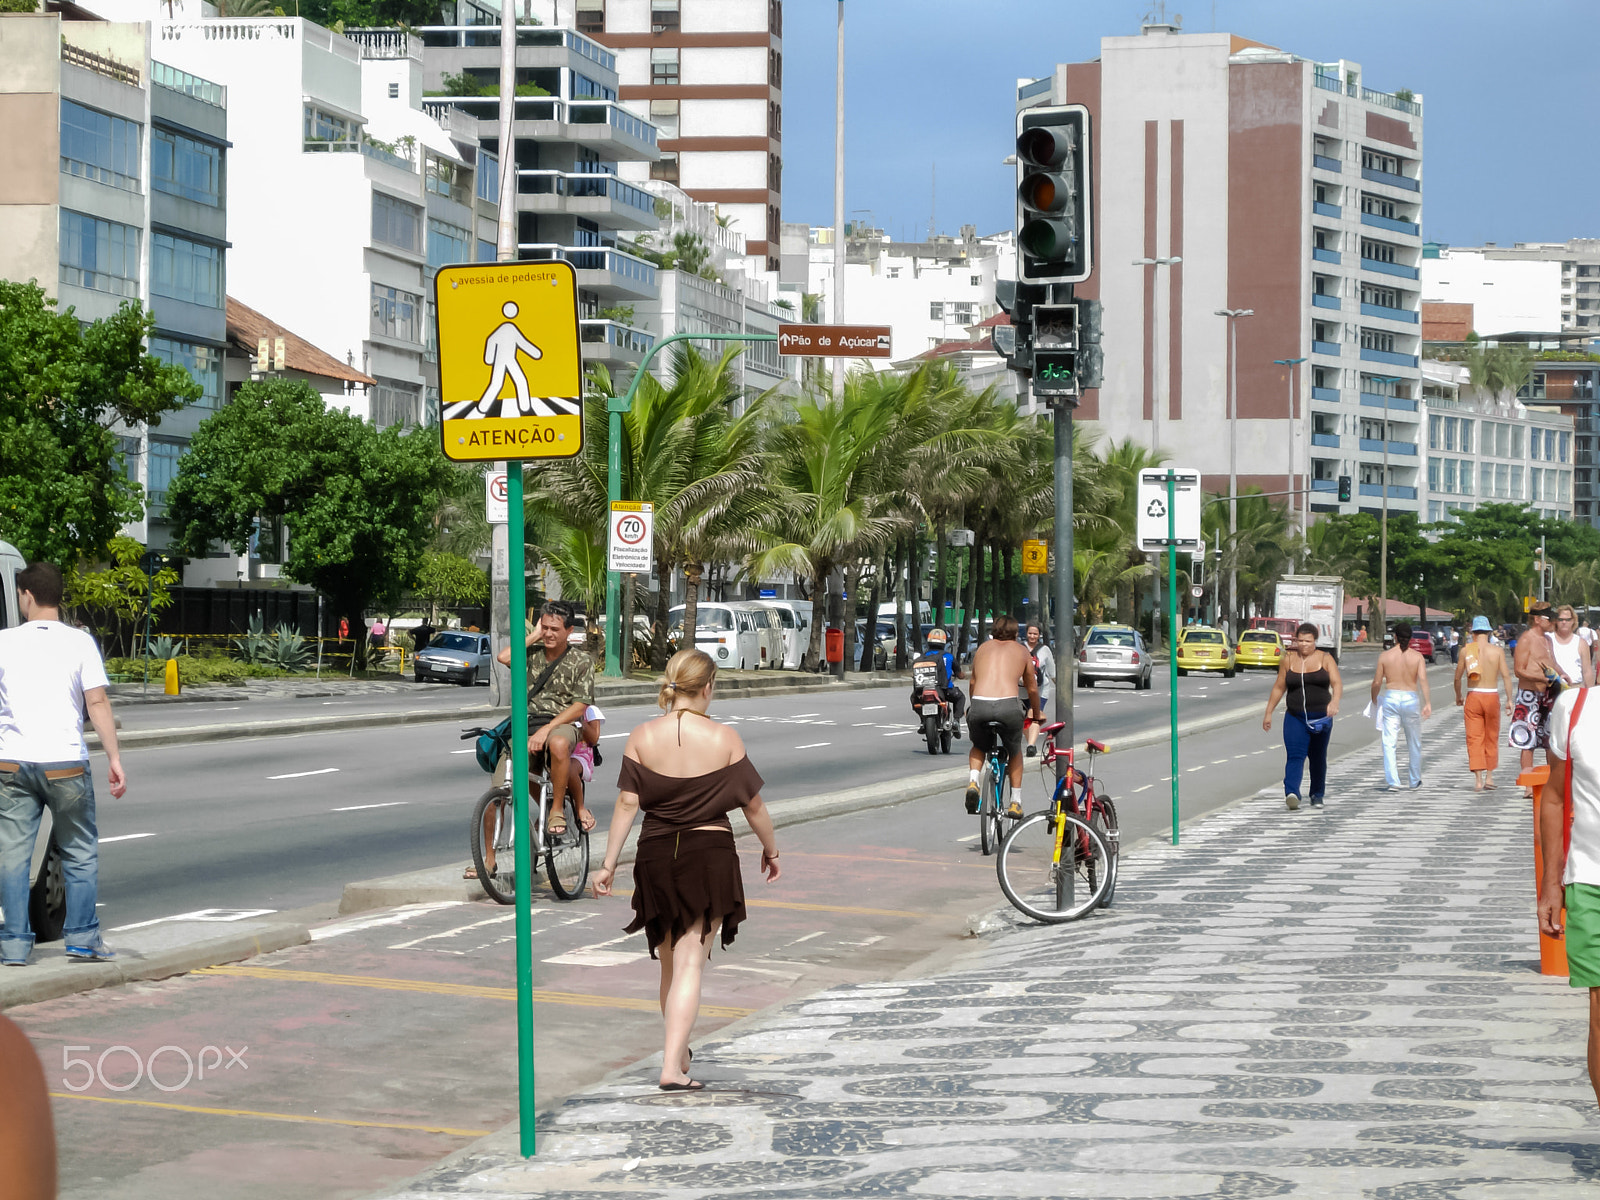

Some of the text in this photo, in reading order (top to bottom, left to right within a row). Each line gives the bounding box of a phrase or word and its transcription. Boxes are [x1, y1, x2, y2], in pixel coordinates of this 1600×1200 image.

[450, 272, 557, 286] avessia de pedestre
[790, 335, 877, 349] Pão de Açúcar
[468, 423, 555, 449] ATENÇÃO
[613, 502, 641, 511] Atenção
[623, 520, 640, 533] 70
